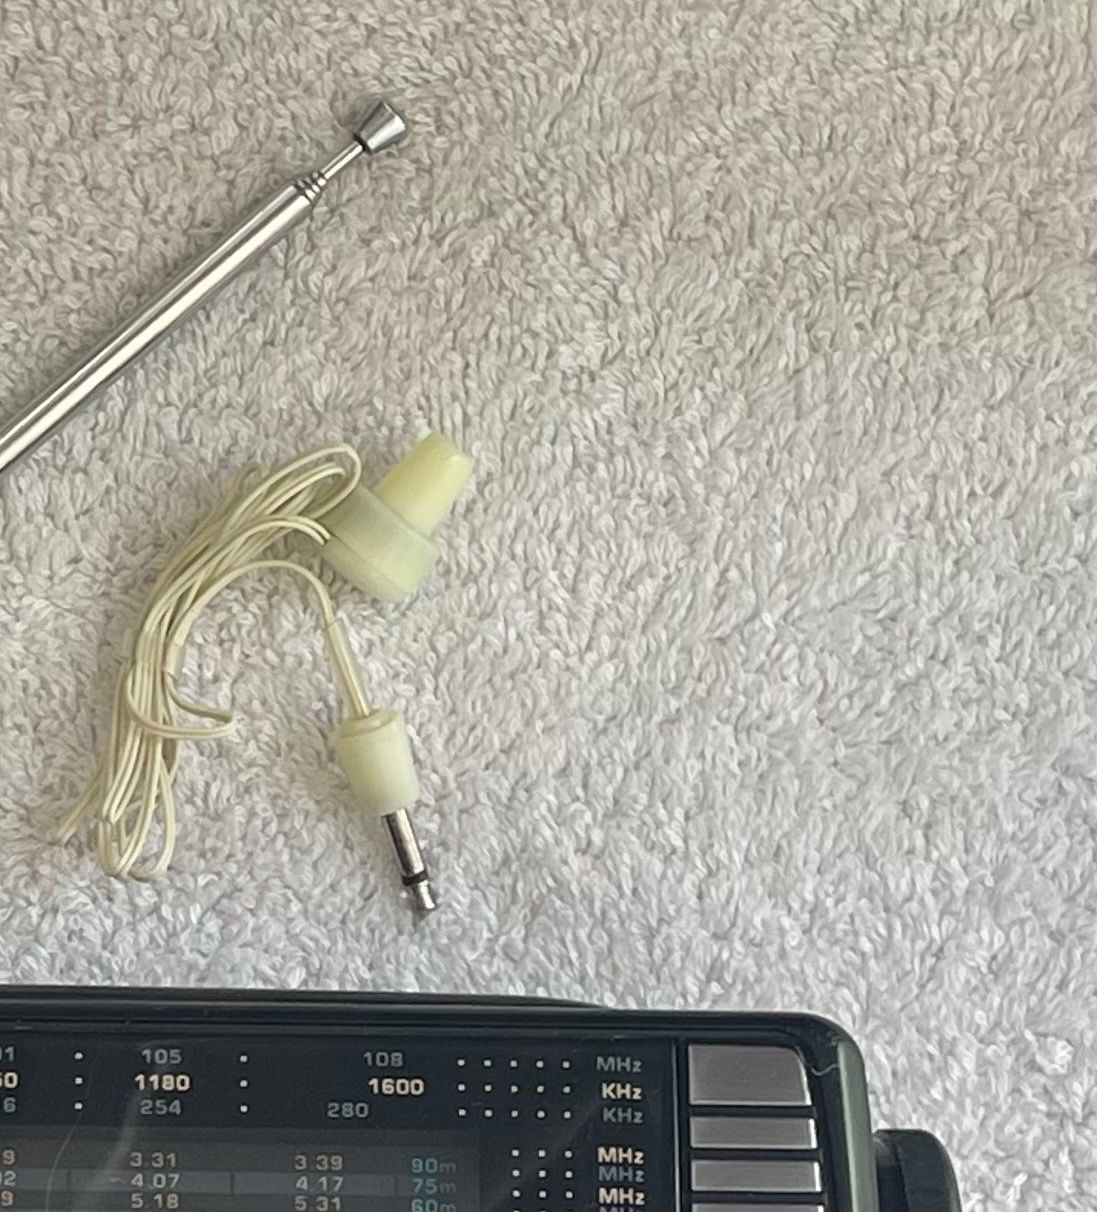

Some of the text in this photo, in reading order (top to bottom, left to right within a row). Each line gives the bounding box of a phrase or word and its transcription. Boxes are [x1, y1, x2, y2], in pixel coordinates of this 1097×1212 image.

[142, 1049, 182, 1064] 105
[363, 1052, 403, 1067] 108
[596, 1056, 642, 1072] MHz
[135, 1074, 190, 1091] 1180
[368, 1078, 424, 1095] 1600
[602, 1083, 642, 1100] KHz
[139, 1099, 182, 1115] 254
[327, 1102, 369, 1118] 280
[603, 1107, 643, 1124] KHz
[597, 1147, 644, 1164] MHz
[598, 1166, 644, 1182] MHz
[598, 1188, 644, 1205] MHz
